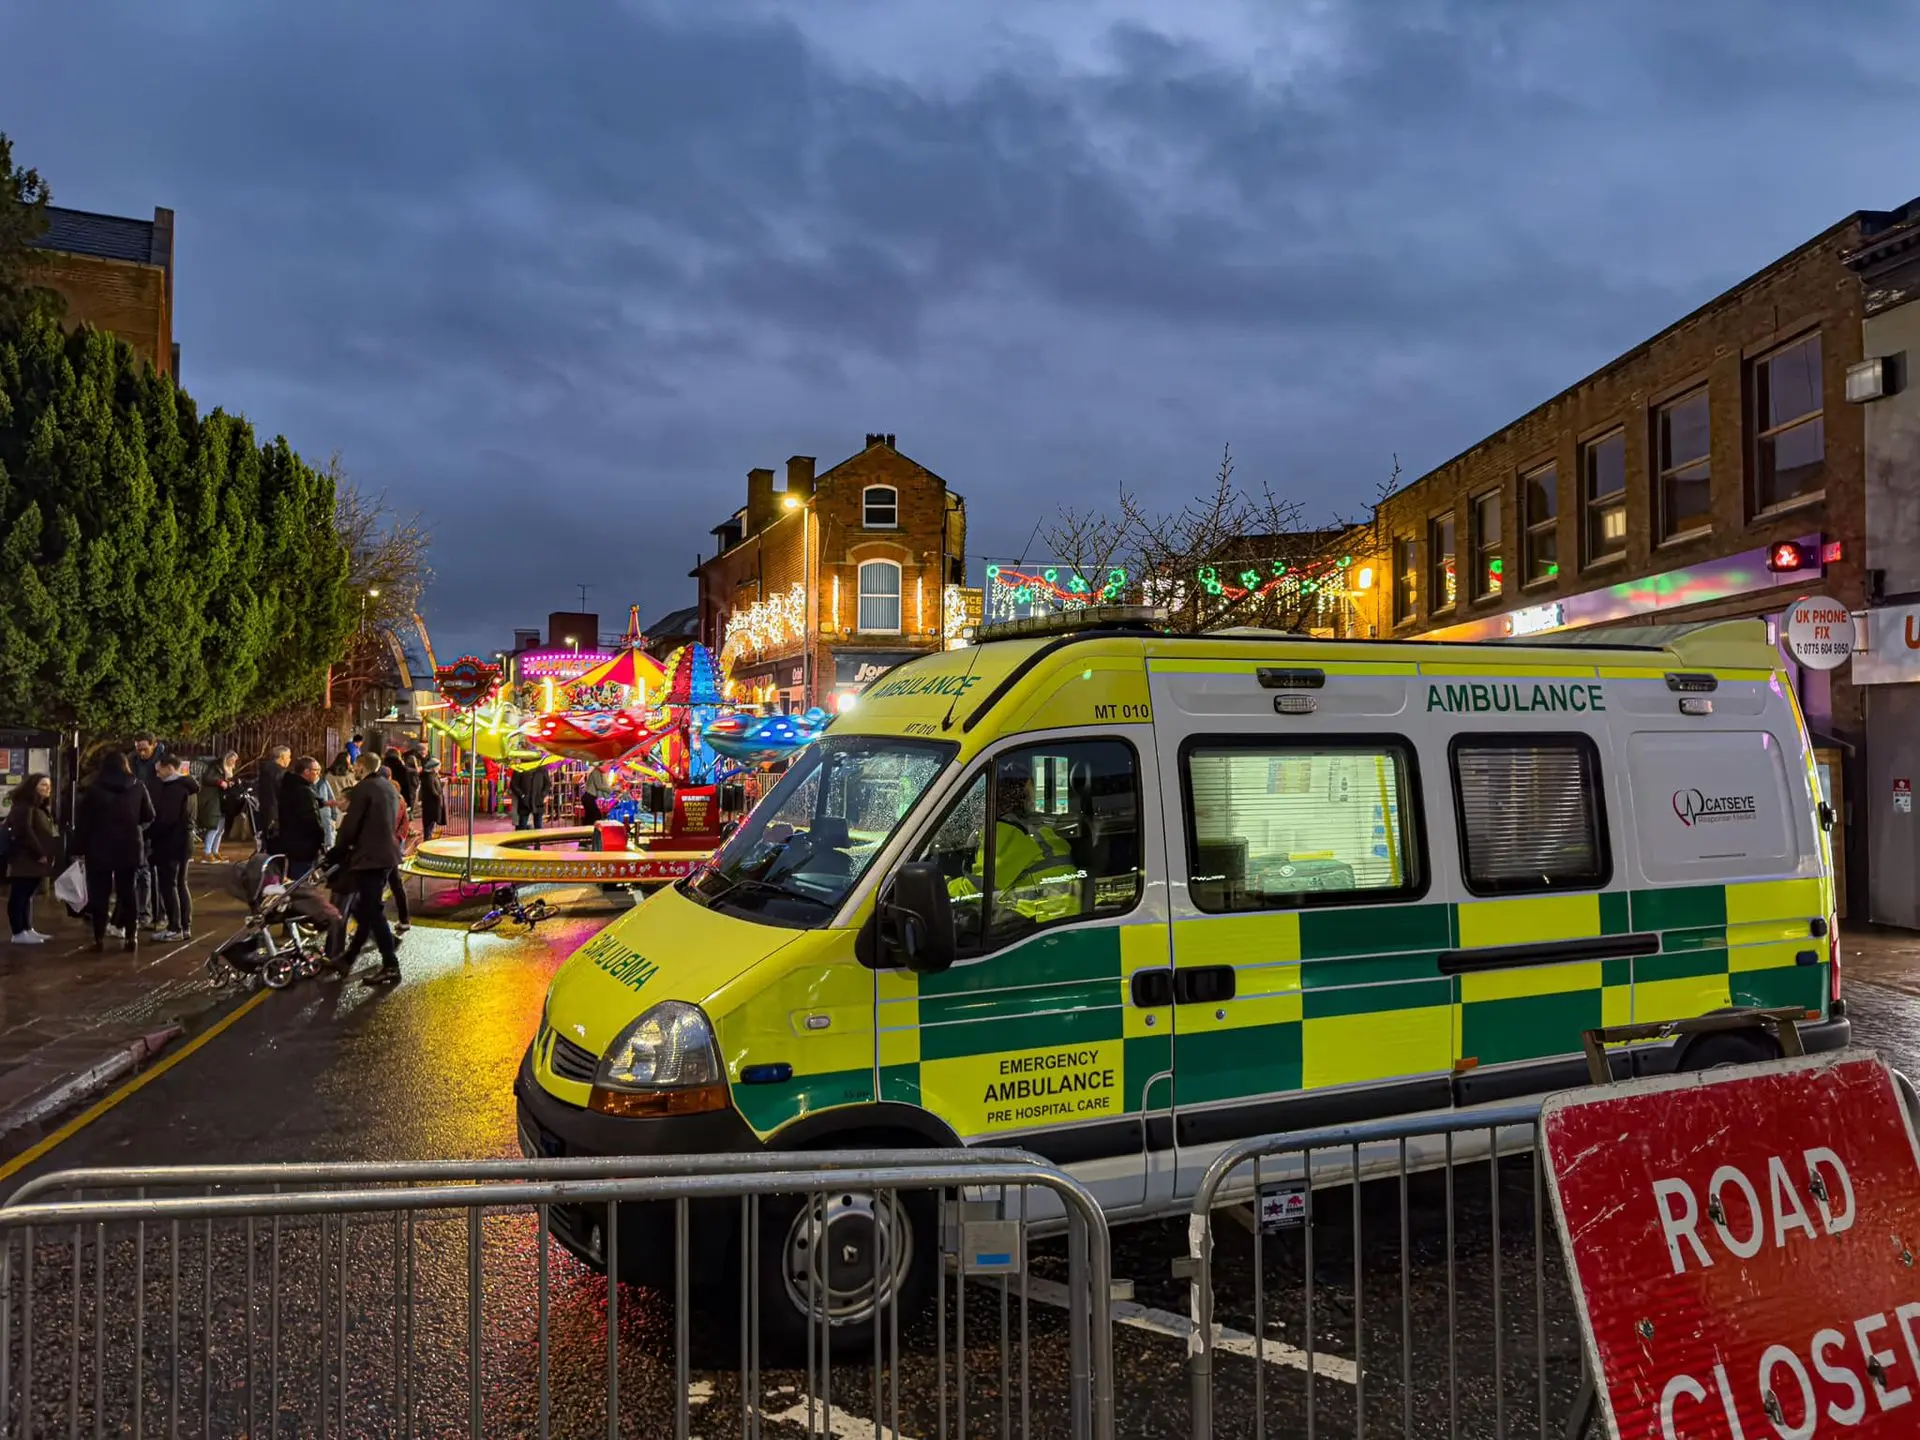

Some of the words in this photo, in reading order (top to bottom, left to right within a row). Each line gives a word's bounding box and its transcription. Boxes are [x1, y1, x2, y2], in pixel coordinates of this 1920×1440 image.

[1796, 610, 1810, 623] UK
[1812, 609, 1847, 623] PHONE
[1815, 626, 1830, 639] FIX
[1796, 644, 1802, 654] T:
[1803, 643, 1819, 654] 0775
[1821, 643, 1832, 654] 604
[872, 676, 982, 698] AMBULANCE
[1427, 684, 1606, 712] AMBULANCE
[1095, 704, 1117, 719] MT
[1122, 704, 1149, 718] 010
[917, 724, 937, 735] 010
[1705, 796, 1755, 811] CATSEYE
[1000, 1050, 1099, 1075] EMERGENCY
[984, 1069, 1115, 1103] AMBULANCE
[987, 1110, 1012, 1123] PRE
[1016, 1104, 1074, 1120] HOSPITAL
[1077, 1097, 1110, 1111] CARE
[1653, 1147, 1856, 1274] ROAD
